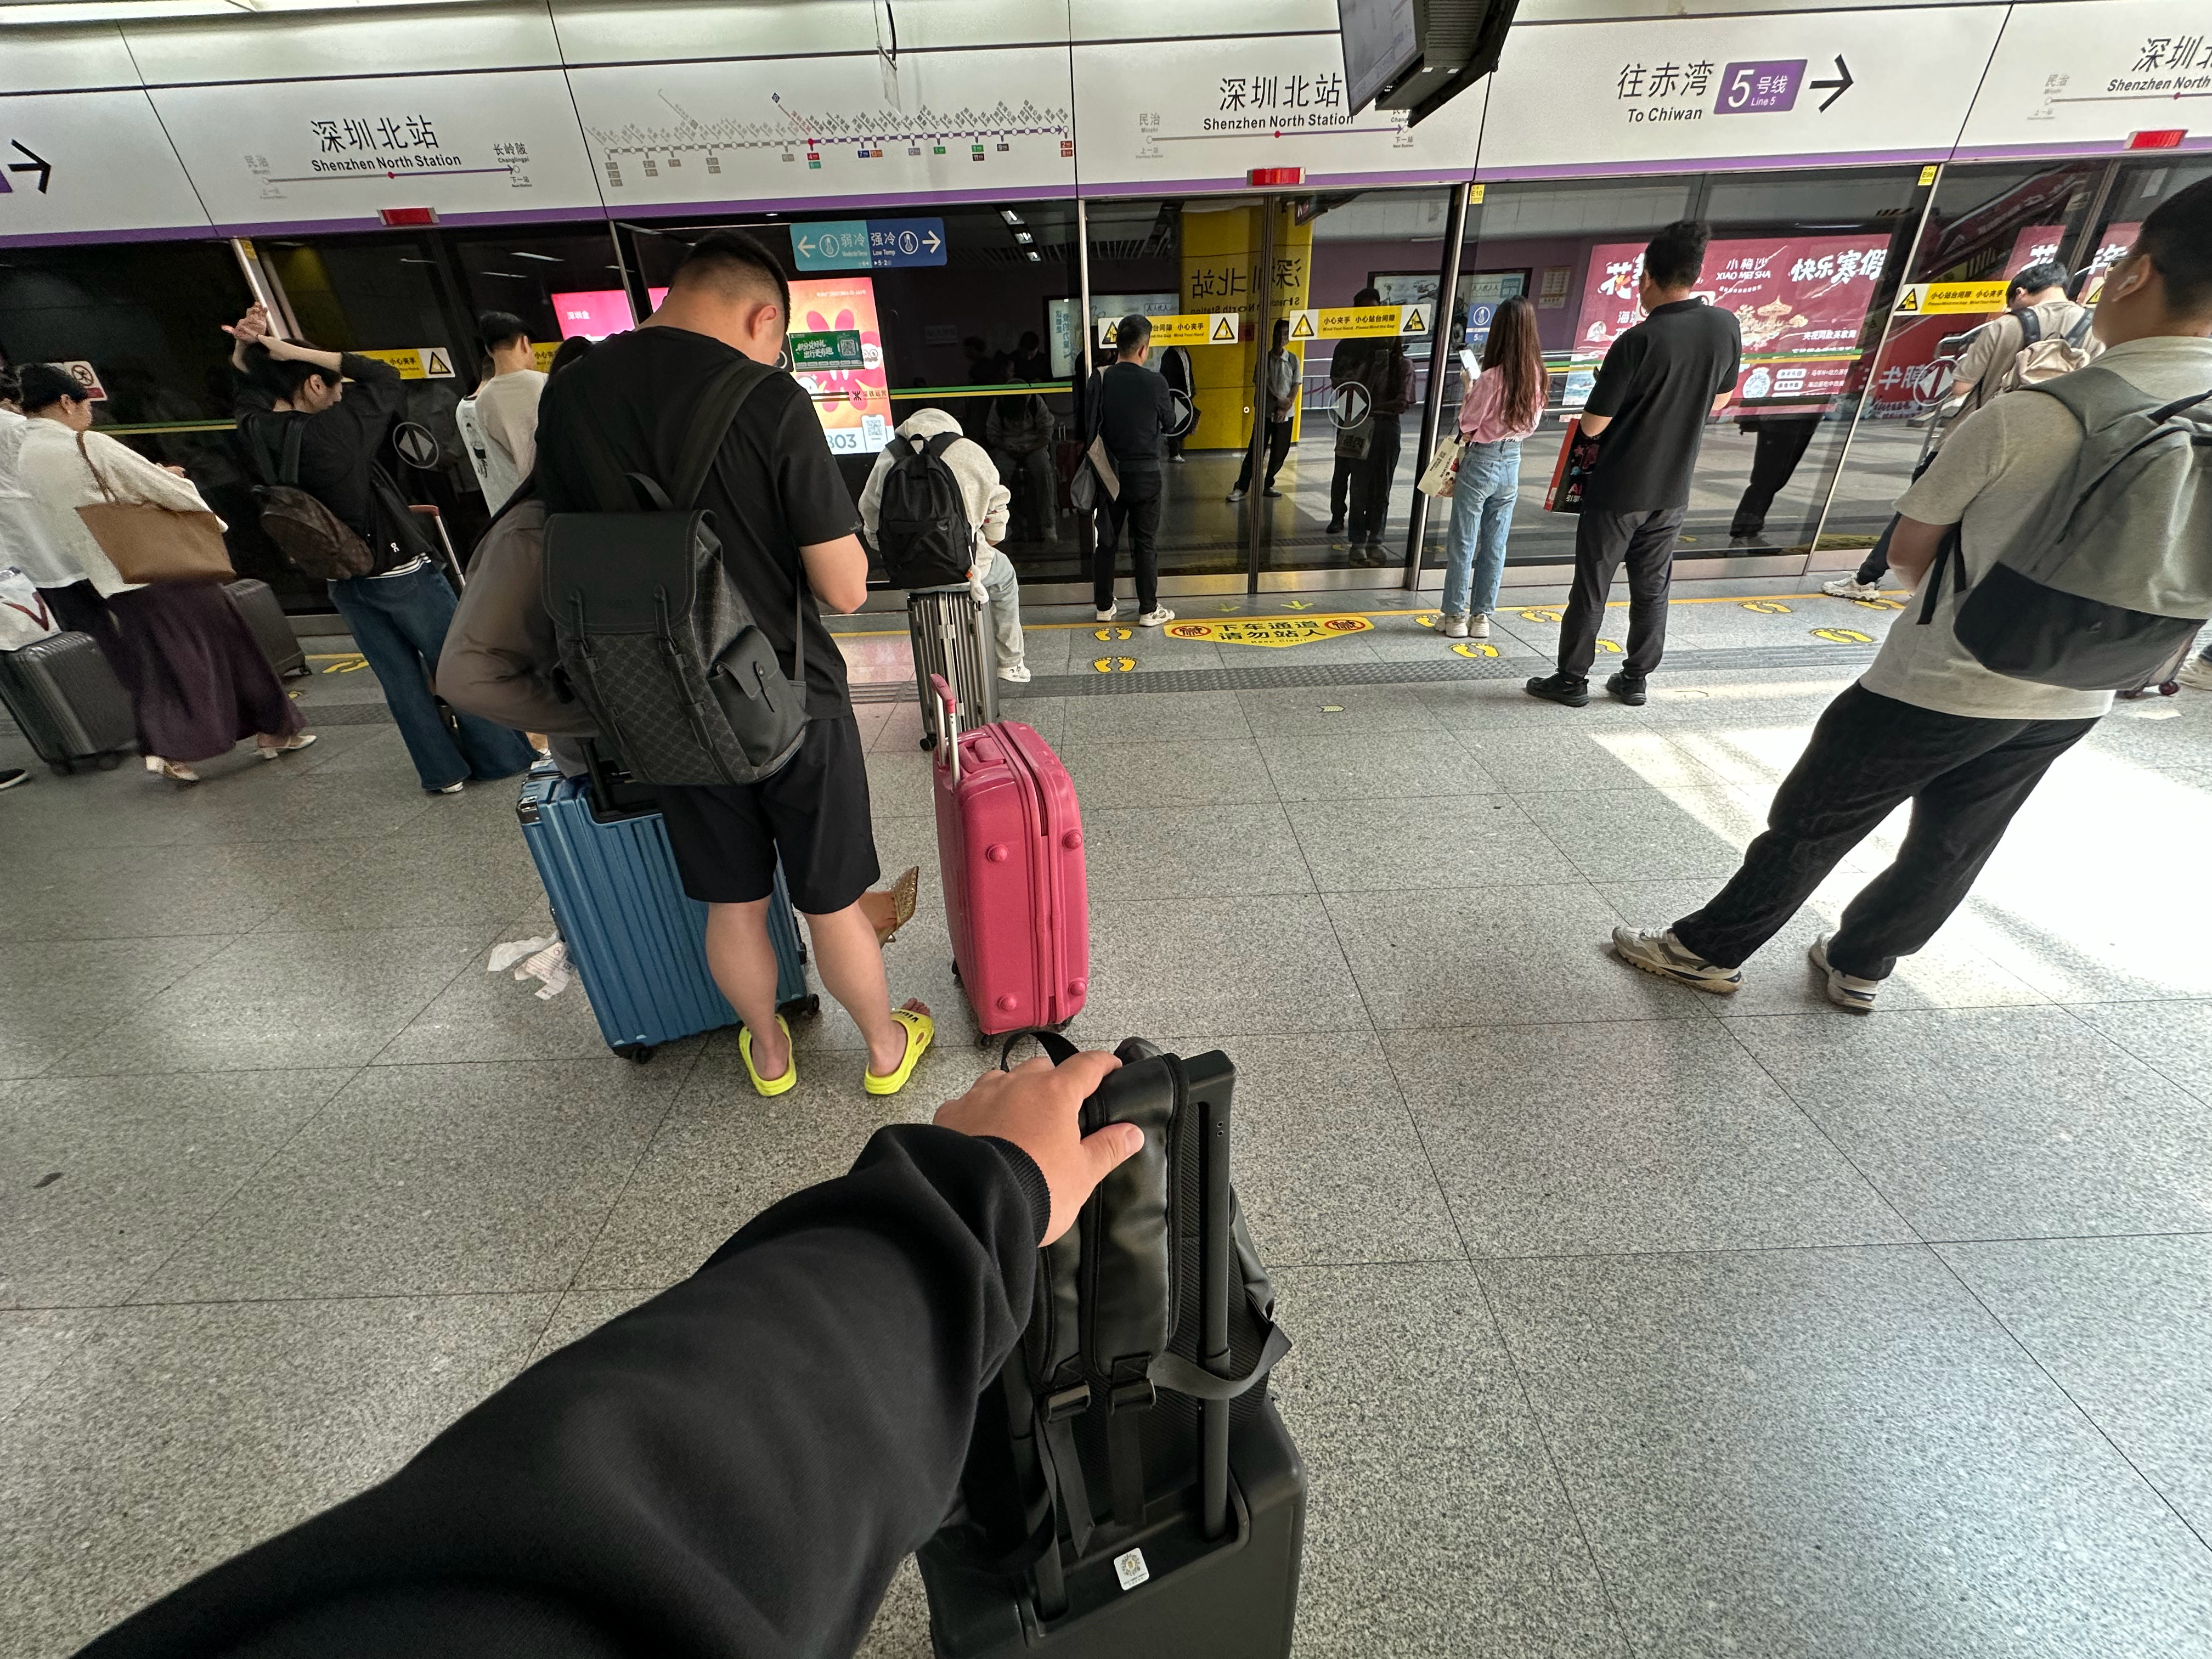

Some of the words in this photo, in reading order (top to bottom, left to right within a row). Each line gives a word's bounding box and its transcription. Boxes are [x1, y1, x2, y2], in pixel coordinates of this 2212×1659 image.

[1617, 59, 1714, 99] 往赤湾
[1756, 75, 1788, 95] 号线
[2107, 77, 2172, 92] Shenzhen
[2172, 75, 2211, 89] North
[1220, 72, 1342, 111] 深圳北站
[1728, 69, 1754, 108] 5
[1751, 97, 1769, 106] Line
[1769, 97, 1776, 105] 5
[1139, 112, 1160, 126] 民治
[1203, 116, 1266, 131] Shenzhen
[1268, 114, 1305, 128] North
[1307, 112, 1353, 127] Station
[1628, 109, 1644, 122] To
[1649, 107, 1702, 122] Chiwan
[311, 114, 439, 153] 深圳北站
[493, 142, 528, 156] 长岭陂
[312, 158, 375, 172] Shenzhen
[376, 155, 414, 169] North
[415, 154, 462, 167] Station
[840, 233, 865, 247] 弱冷
[870, 232, 896, 246] 强冷
[1726, 257, 1769, 271] 小梅沙
[1790, 249, 1888, 284] 快乐寒假
[1716, 272, 1737, 280] XIAO
[1739, 271, 1754, 280] MEI
[1755, 270, 1771, 279] SHA
[1323, 317, 1350, 325] 小心夹手
[1355, 314, 1396, 323] 小心站台间隙
[1177, 323, 1204, 331] 小心夹手
[1214, 620, 1320, 632] 下车通道
[1218, 629, 1327, 640] 请勿站人
